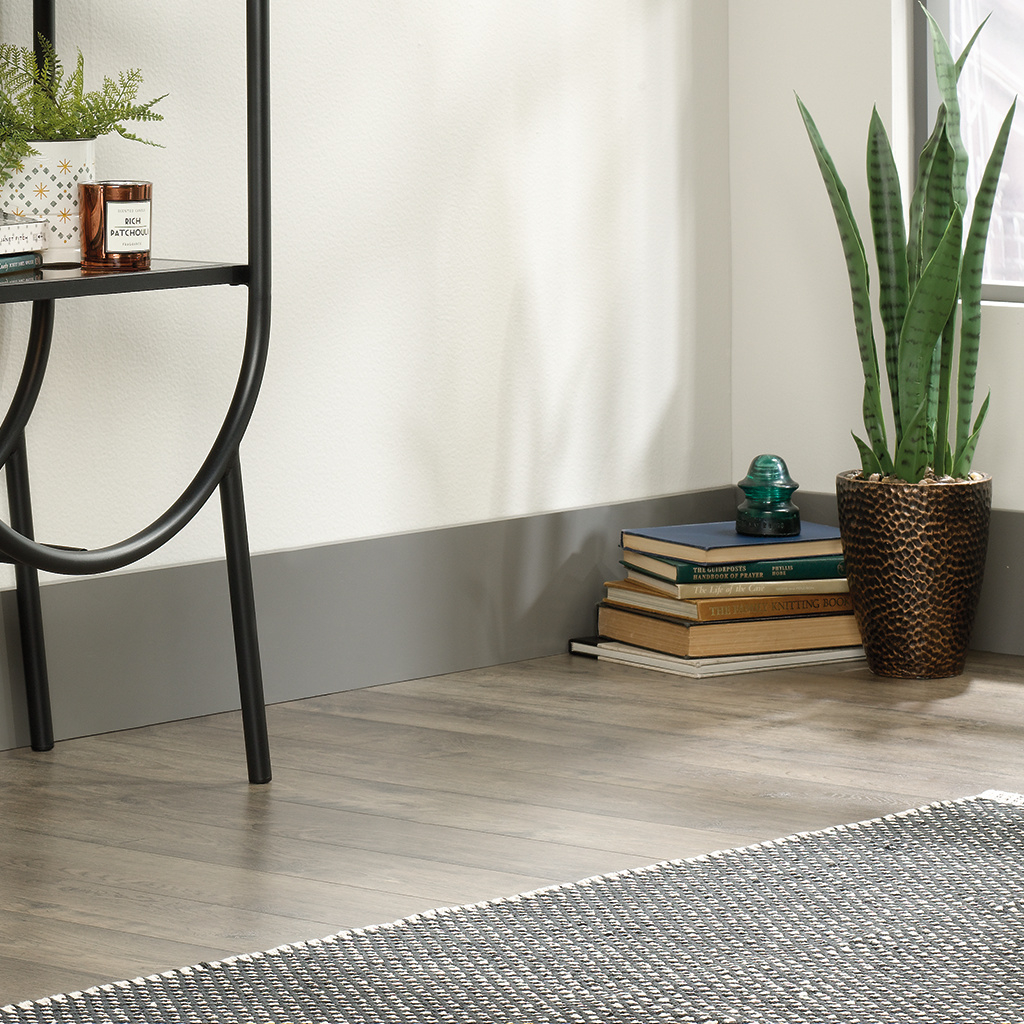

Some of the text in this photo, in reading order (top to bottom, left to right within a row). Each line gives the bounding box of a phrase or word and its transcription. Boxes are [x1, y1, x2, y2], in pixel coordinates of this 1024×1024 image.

[125, 217, 141, 225] RICH
[694, 585, 707, 594] The
[709, 585, 723, 595] Life
[725, 584, 733, 595] of
[736, 584, 747, 593] the
[709, 606, 731, 616] THE
[771, 598, 820, 611] KNITTING
[823, 597, 851, 608] BOOK
